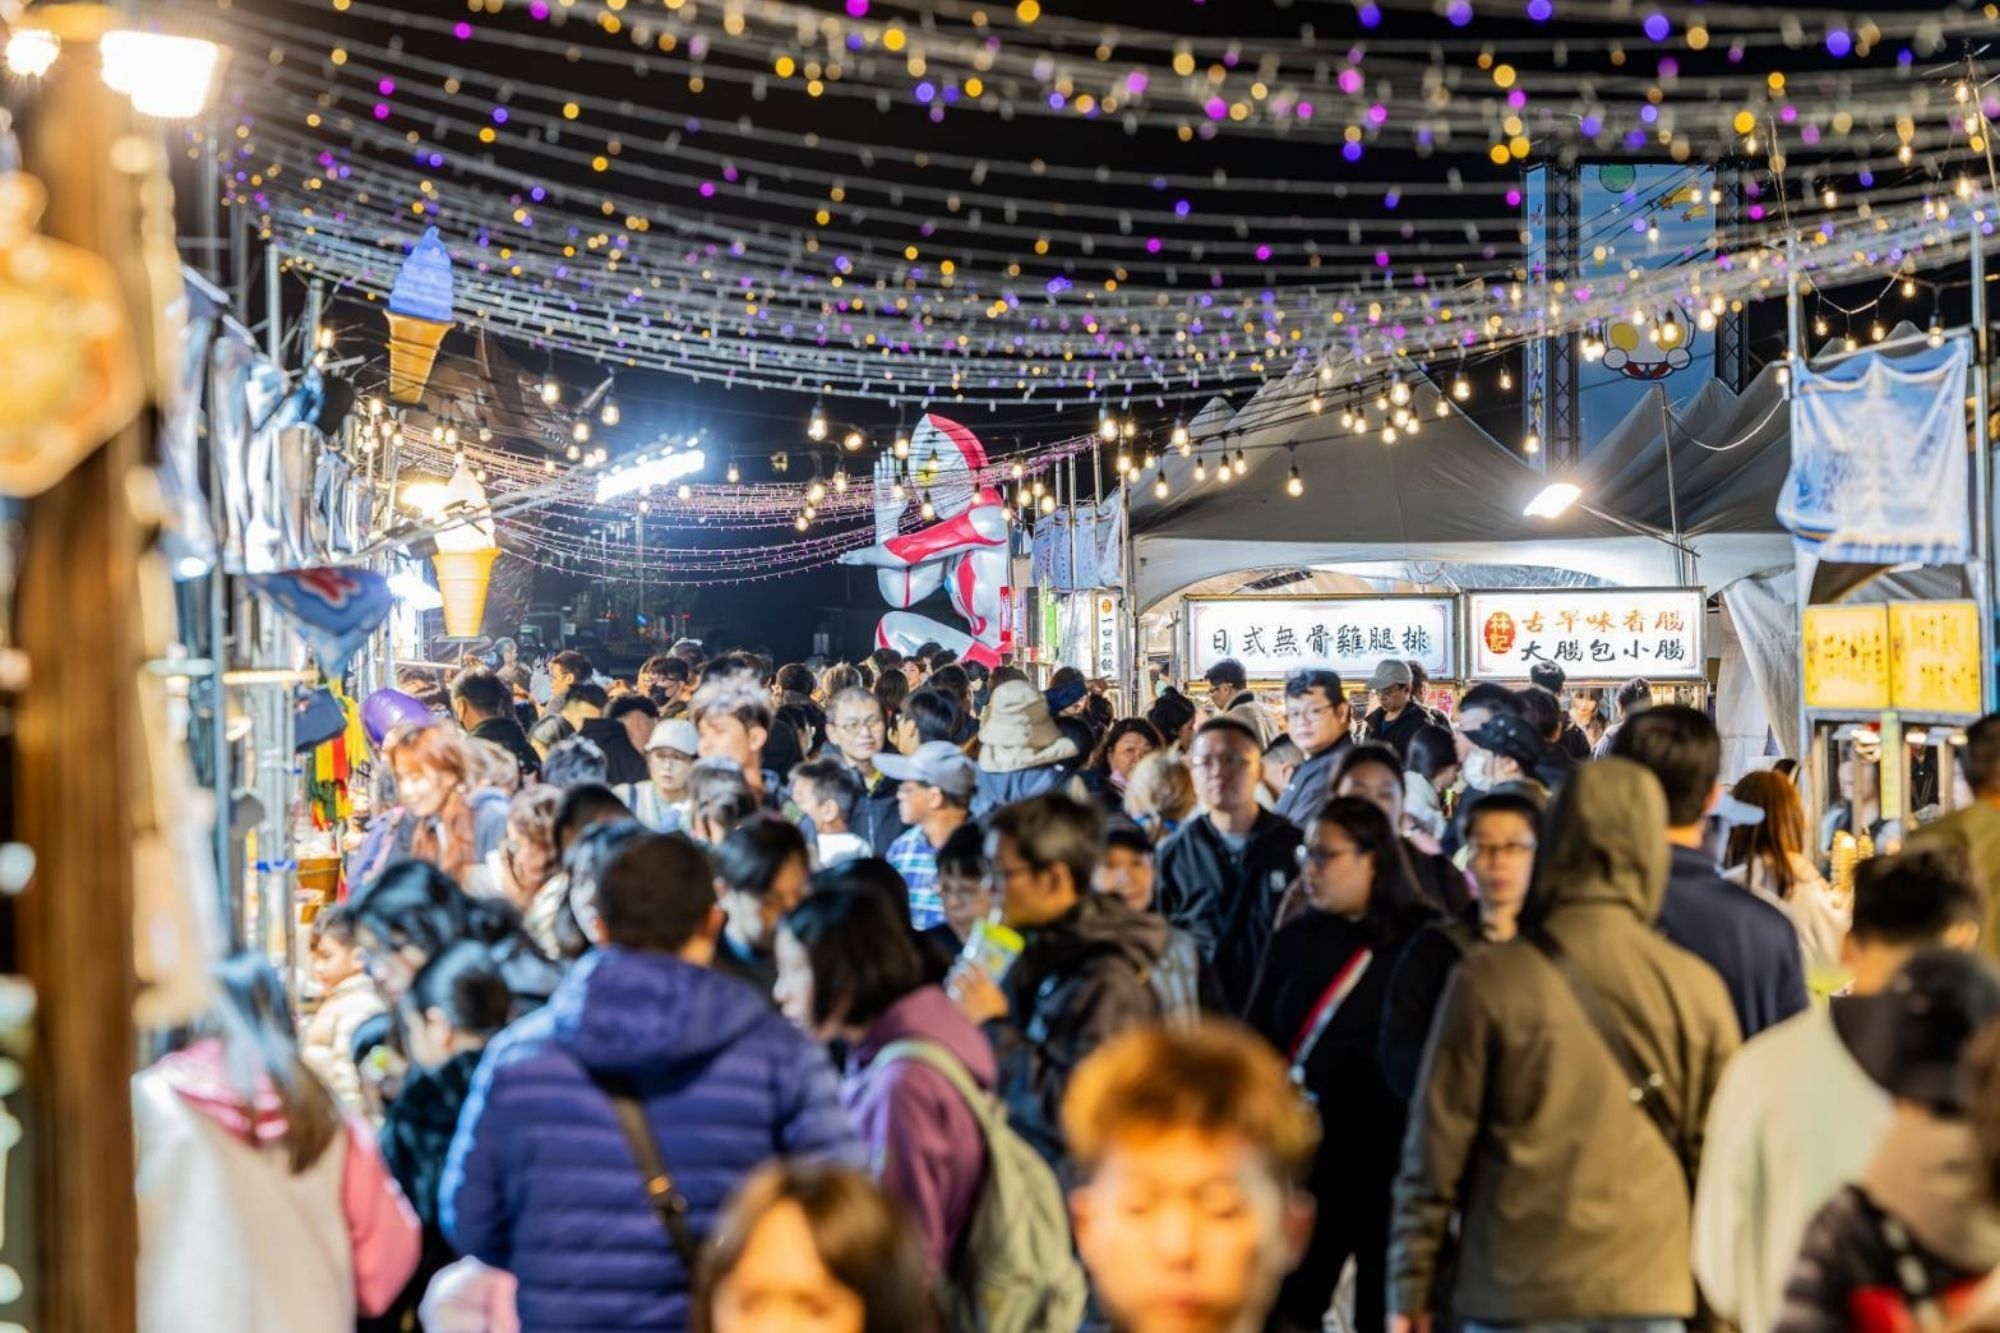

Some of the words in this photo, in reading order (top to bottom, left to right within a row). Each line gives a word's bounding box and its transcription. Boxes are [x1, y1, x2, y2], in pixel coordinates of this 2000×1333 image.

[1521, 609, 1685, 634] 古早味香腸
[1212, 623, 1430, 656] 日式無骨雞腿排
[1520, 638, 1685, 663] 大腸包小腸
